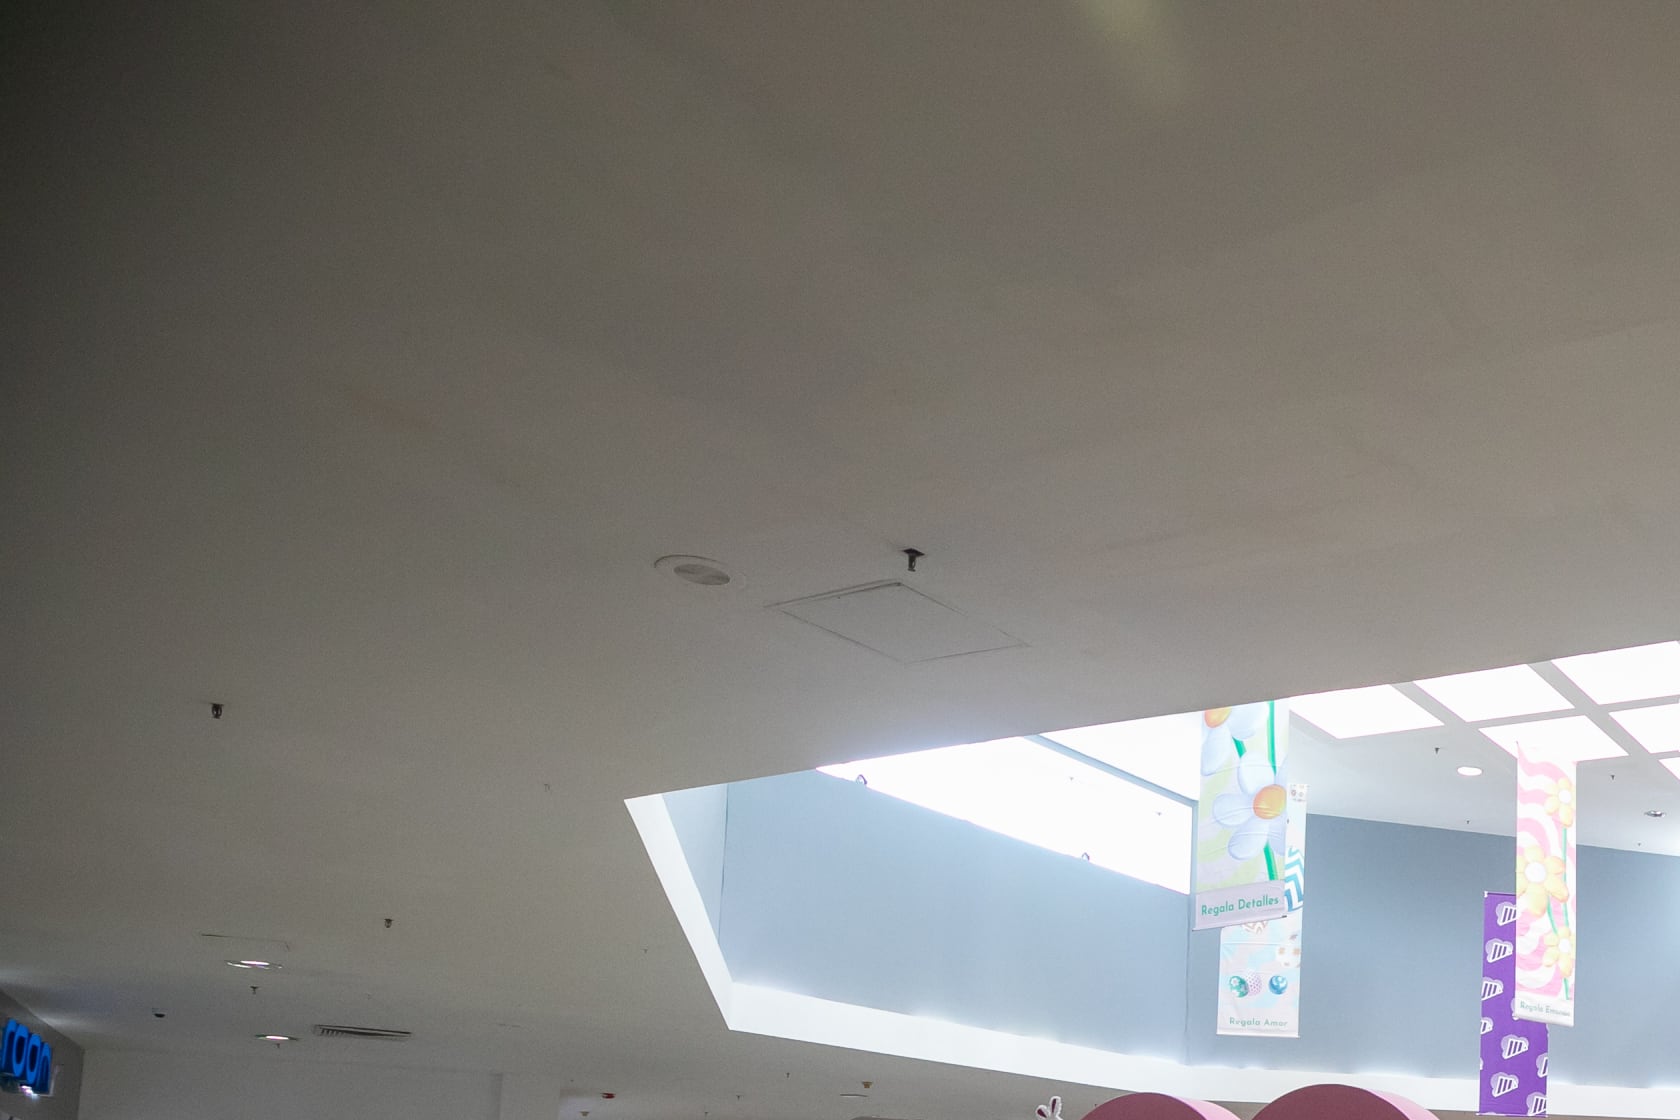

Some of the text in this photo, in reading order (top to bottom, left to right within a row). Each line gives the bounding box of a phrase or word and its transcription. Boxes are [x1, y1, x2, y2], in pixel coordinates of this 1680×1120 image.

[1201, 894, 1279, 916] Regala Detalles
[1229, 1016, 1288, 1027] Regala Amor
